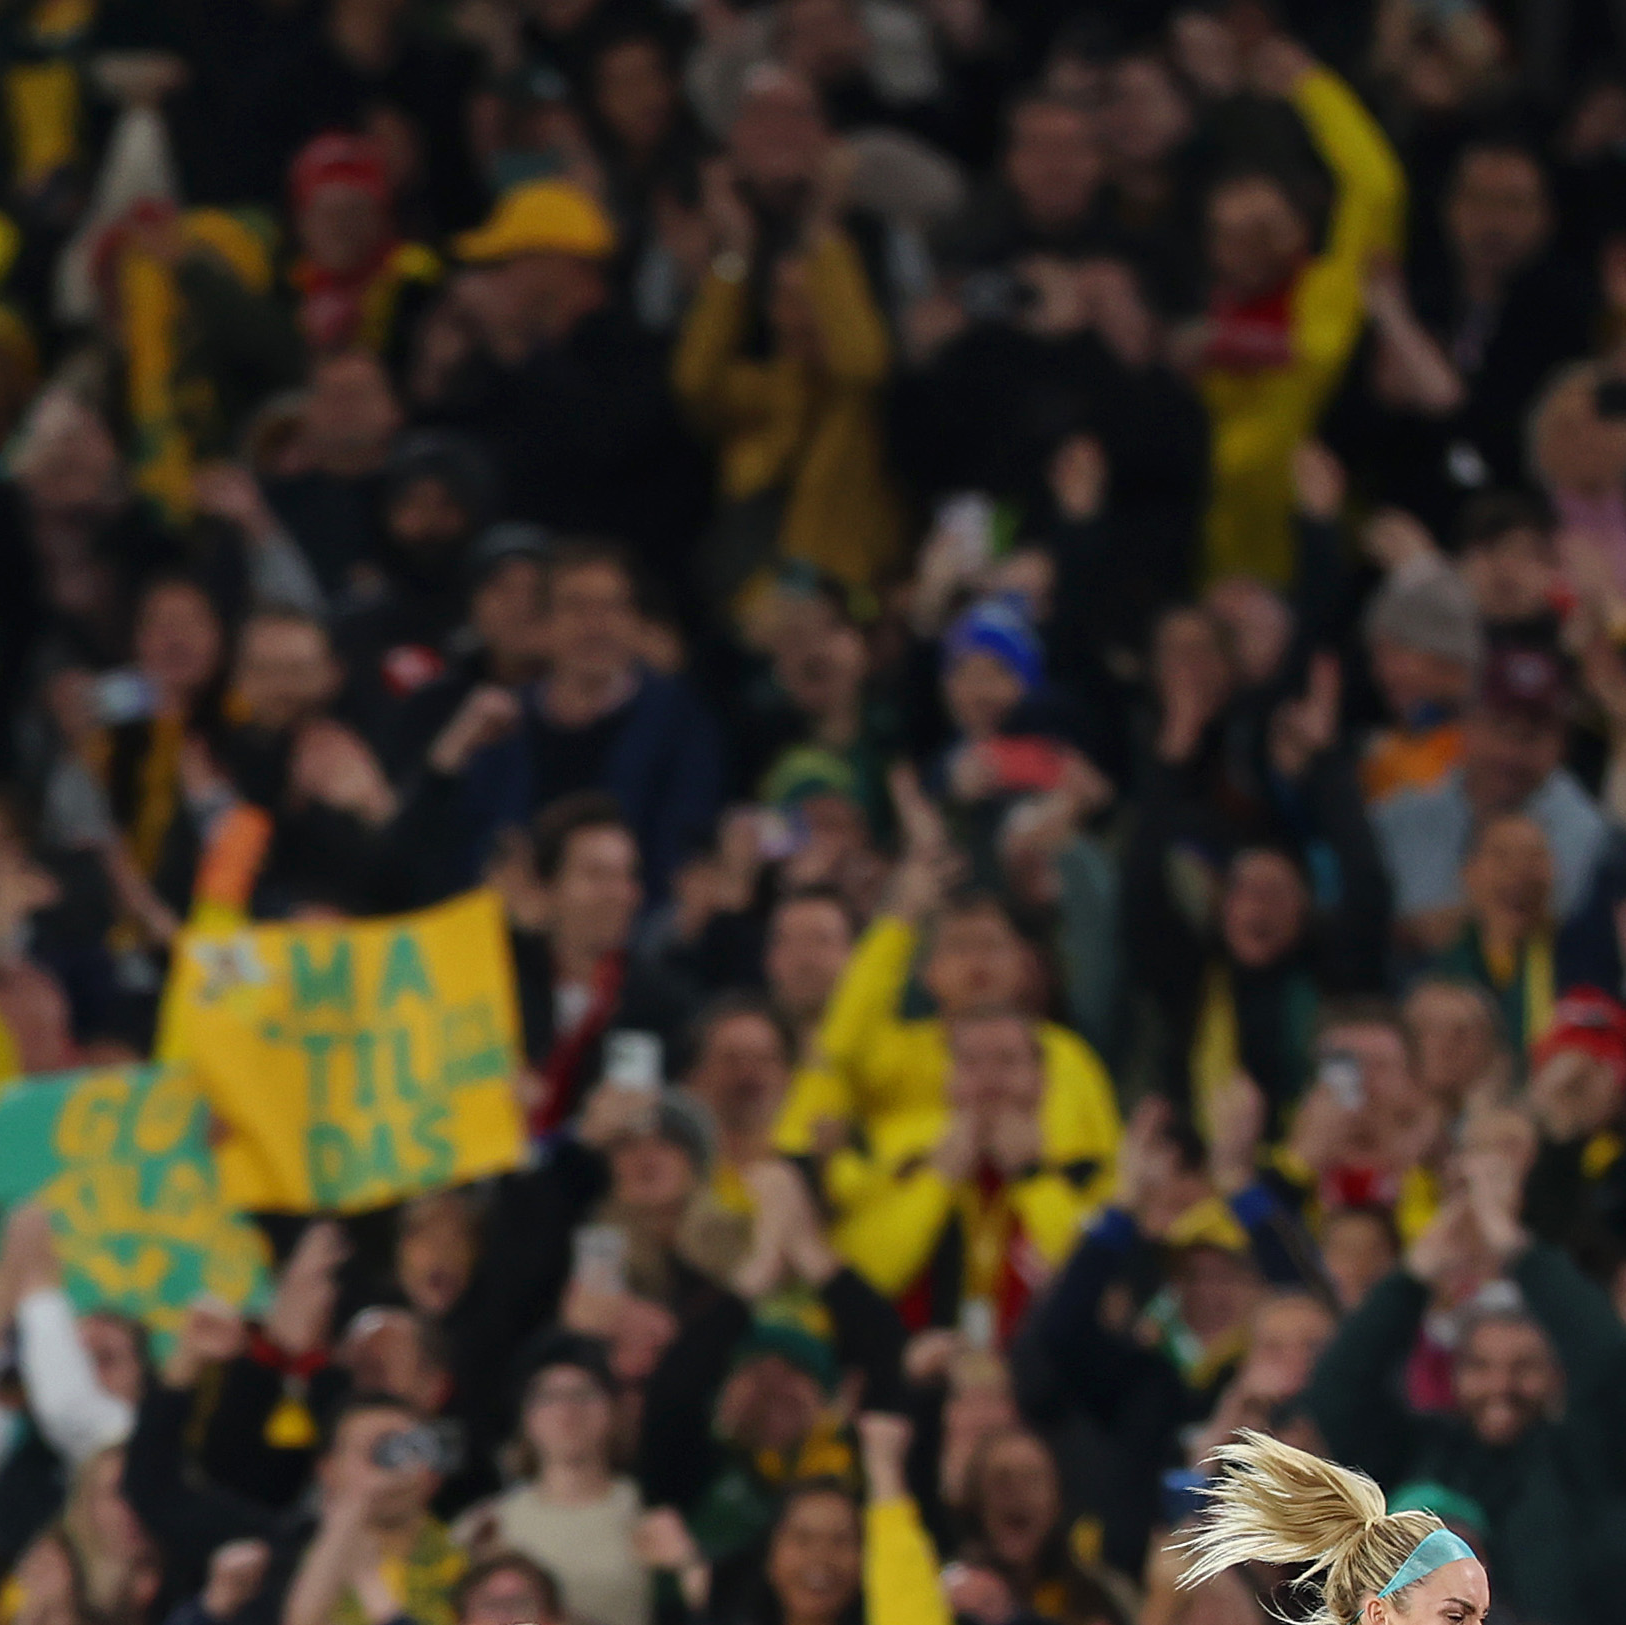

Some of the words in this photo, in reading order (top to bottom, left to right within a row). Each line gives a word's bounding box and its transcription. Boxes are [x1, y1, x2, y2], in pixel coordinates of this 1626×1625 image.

[289, 930, 435, 1010] MA
[301, 1027, 423, 1110] TIL
[55, 1074, 202, 1157] GO
[307, 1104, 455, 1207] DAS
